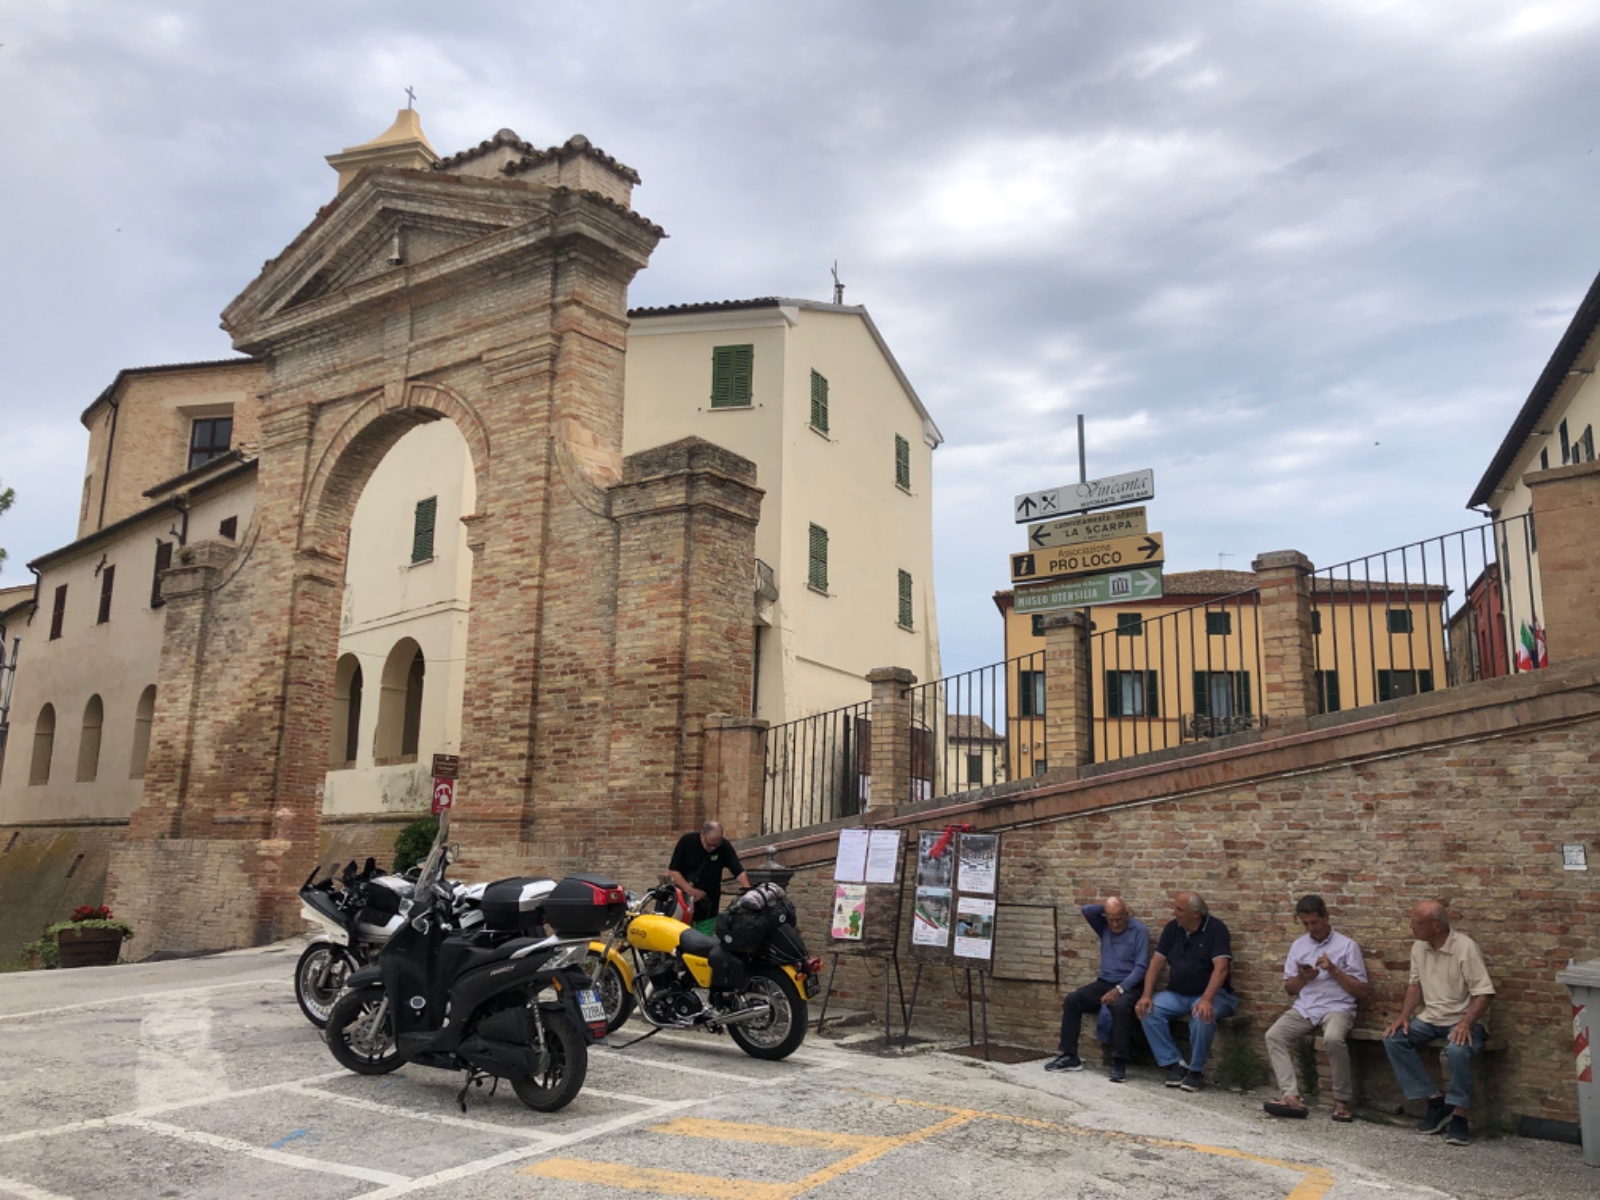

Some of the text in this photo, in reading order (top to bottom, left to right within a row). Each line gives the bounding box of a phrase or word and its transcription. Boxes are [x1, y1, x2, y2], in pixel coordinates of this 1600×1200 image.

[1058, 544, 1112, 557] Associazione
[1049, 551, 1122, 572] PRO LOCO
[1018, 588, 1098, 607] MUSEO UTENSILIA
